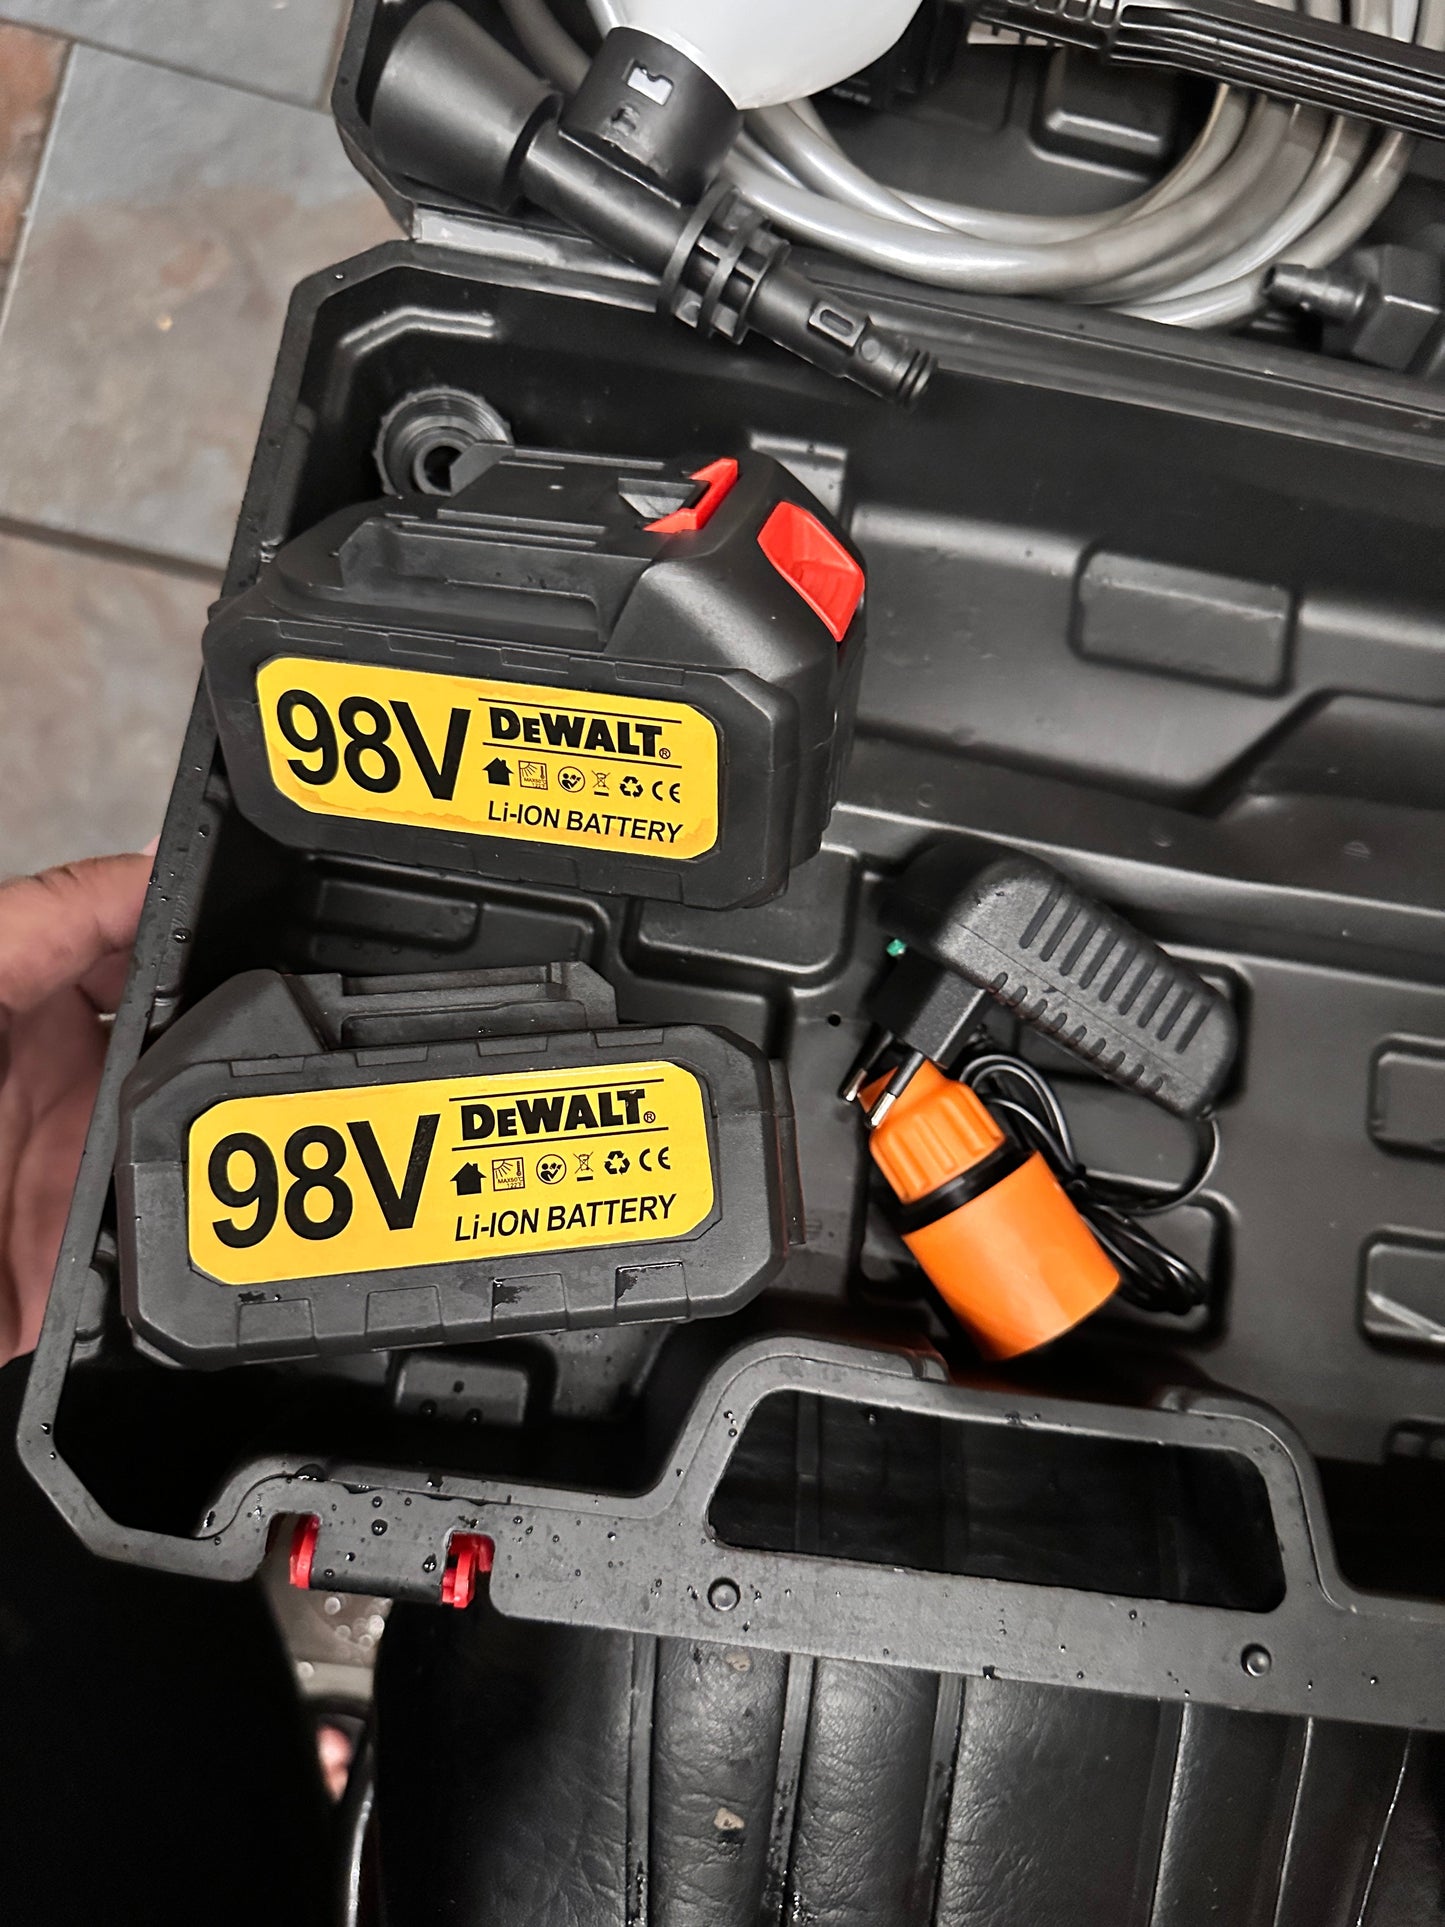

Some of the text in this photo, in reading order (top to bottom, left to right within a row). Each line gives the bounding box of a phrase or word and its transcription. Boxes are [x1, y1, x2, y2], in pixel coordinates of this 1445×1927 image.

[276, 689, 471, 801] 98V
[488, 800, 684, 844] Li-ION BATTERY
[207, 1113, 440, 1249] 98V
[455, 1193, 678, 1242] Li-ION BATTERY
